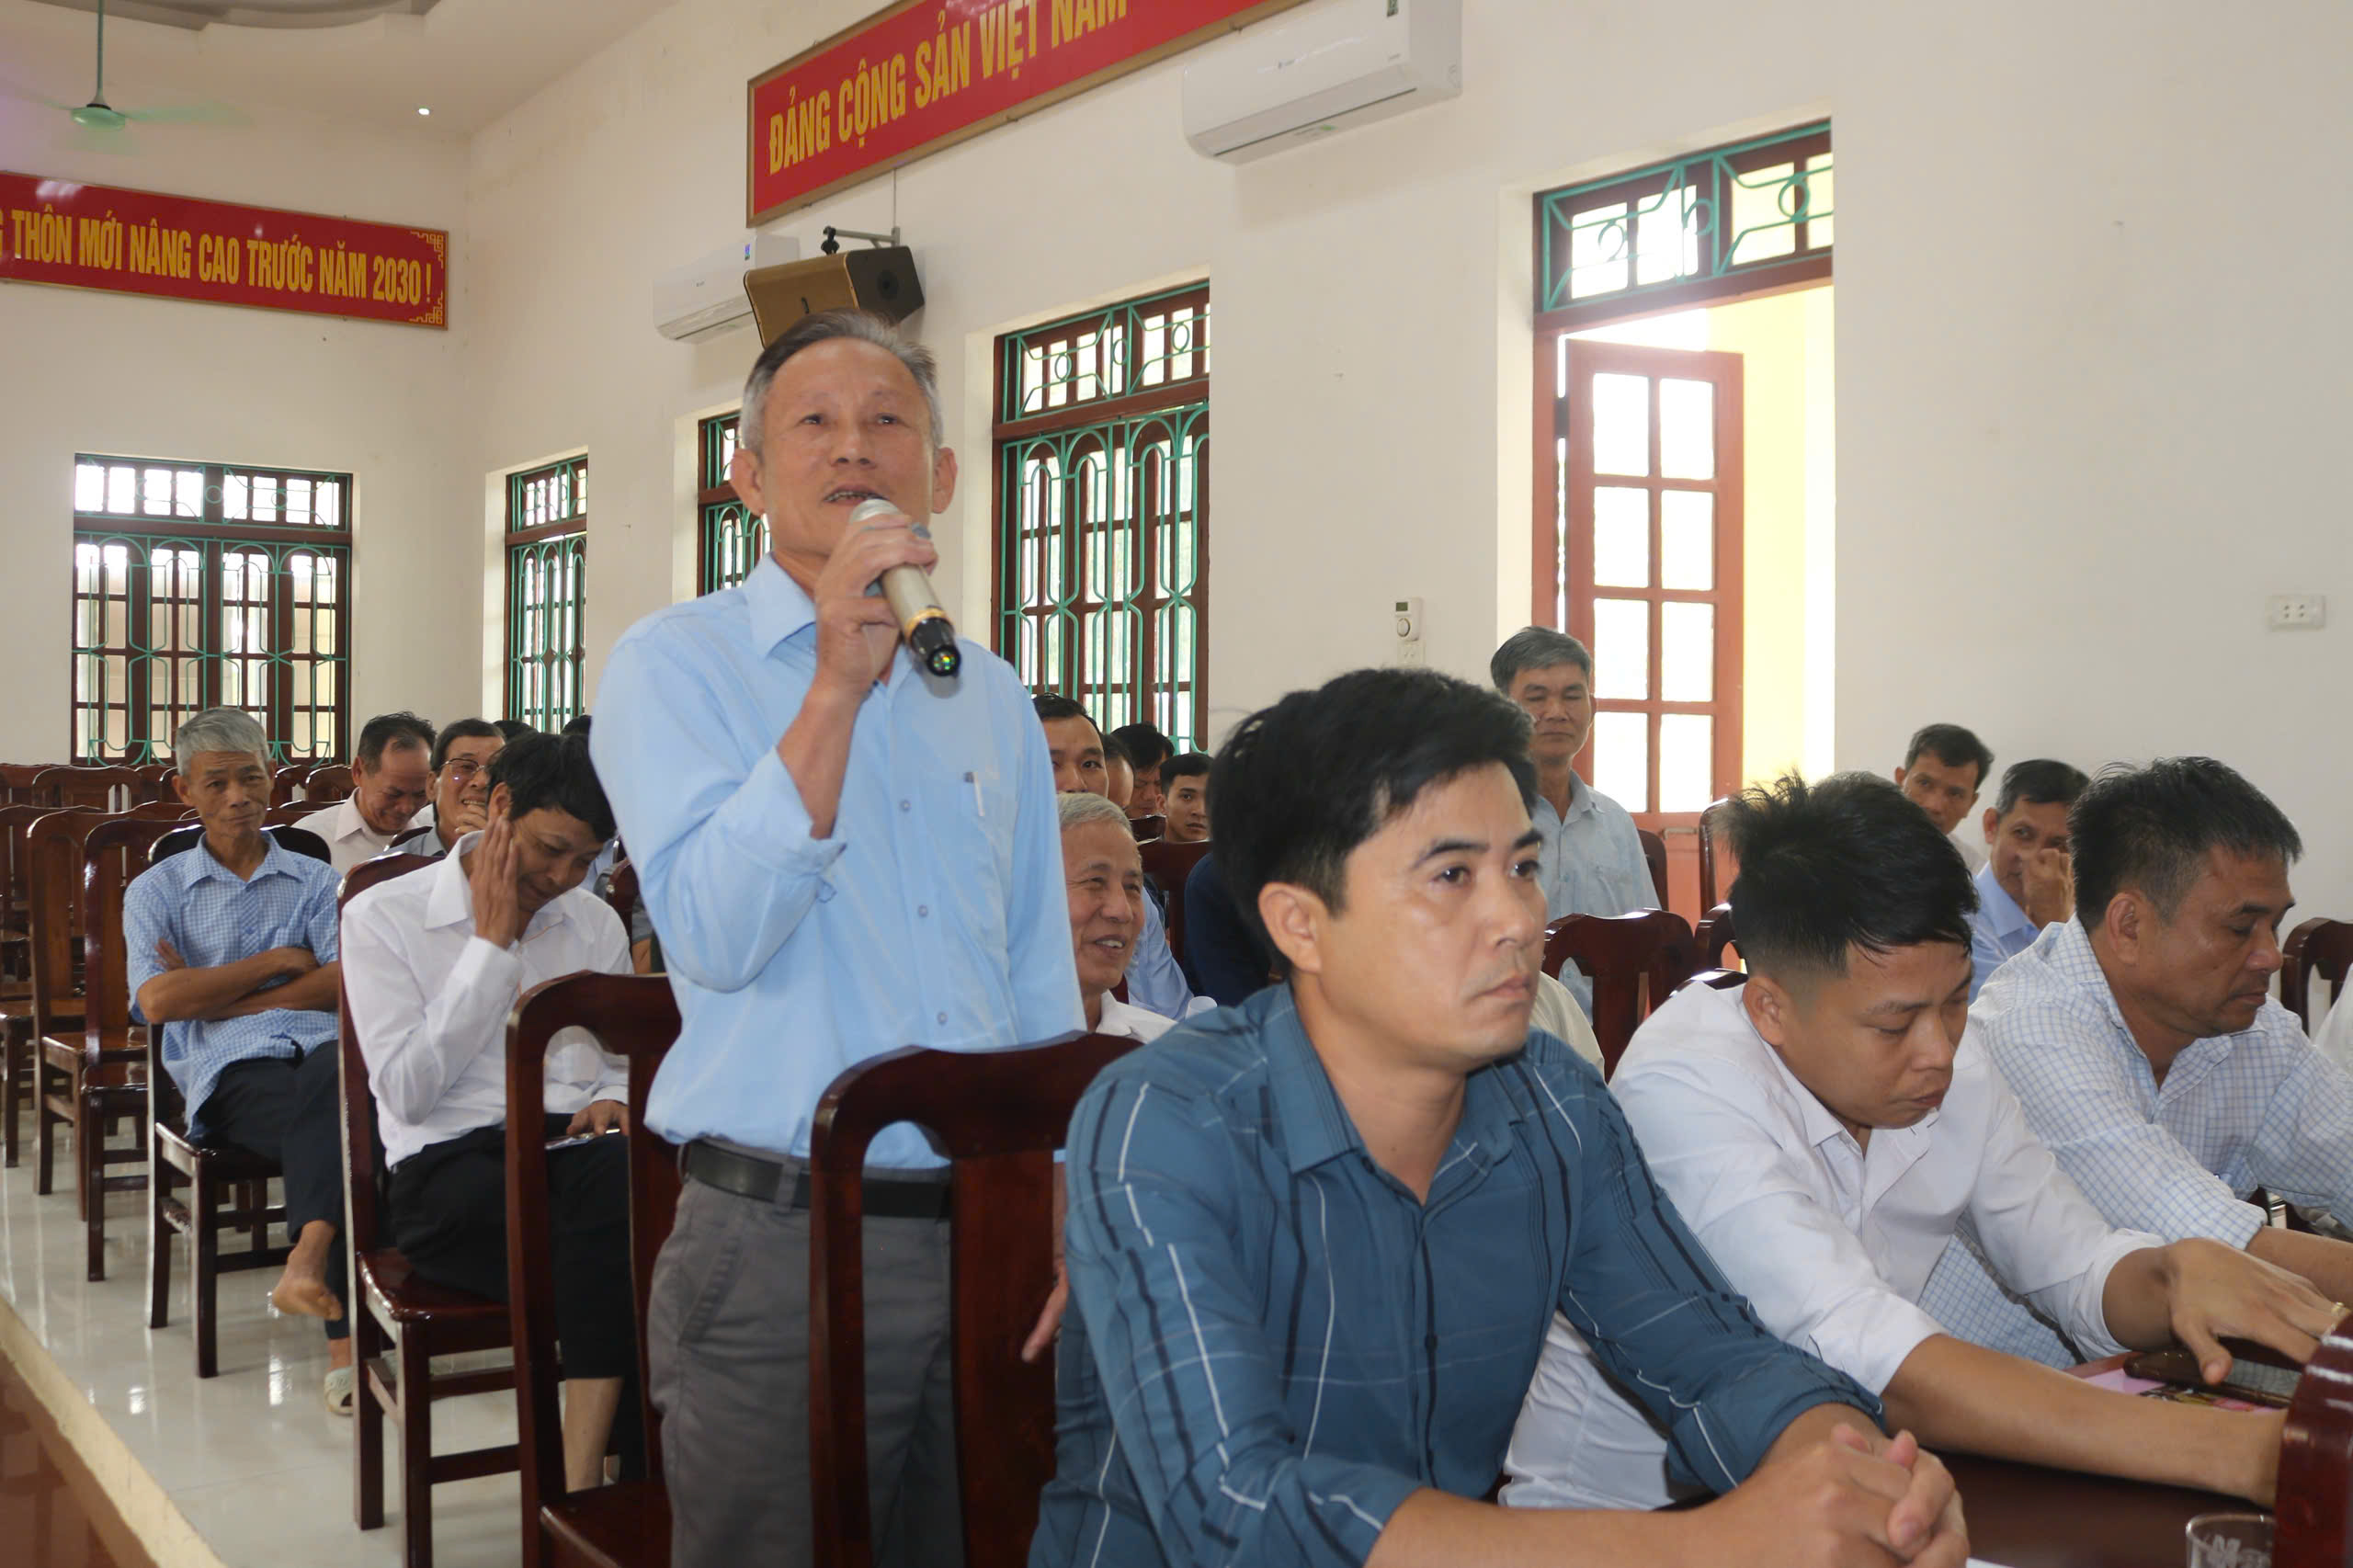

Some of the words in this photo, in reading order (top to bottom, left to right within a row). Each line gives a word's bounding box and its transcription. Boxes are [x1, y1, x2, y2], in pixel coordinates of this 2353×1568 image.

[768, 85, 831, 176] ĐẢNG
[837, 52, 906, 148] CỘNG
[915, 9, 971, 109] SẢN
[11, 203, 73, 265] THÔN
[79, 209, 123, 270] MỚI
[130, 217, 192, 279] NÂNG
[199, 233, 240, 285] CAO
[246, 233, 313, 293] TRƯỚC
[319, 240, 367, 299] NĂM
